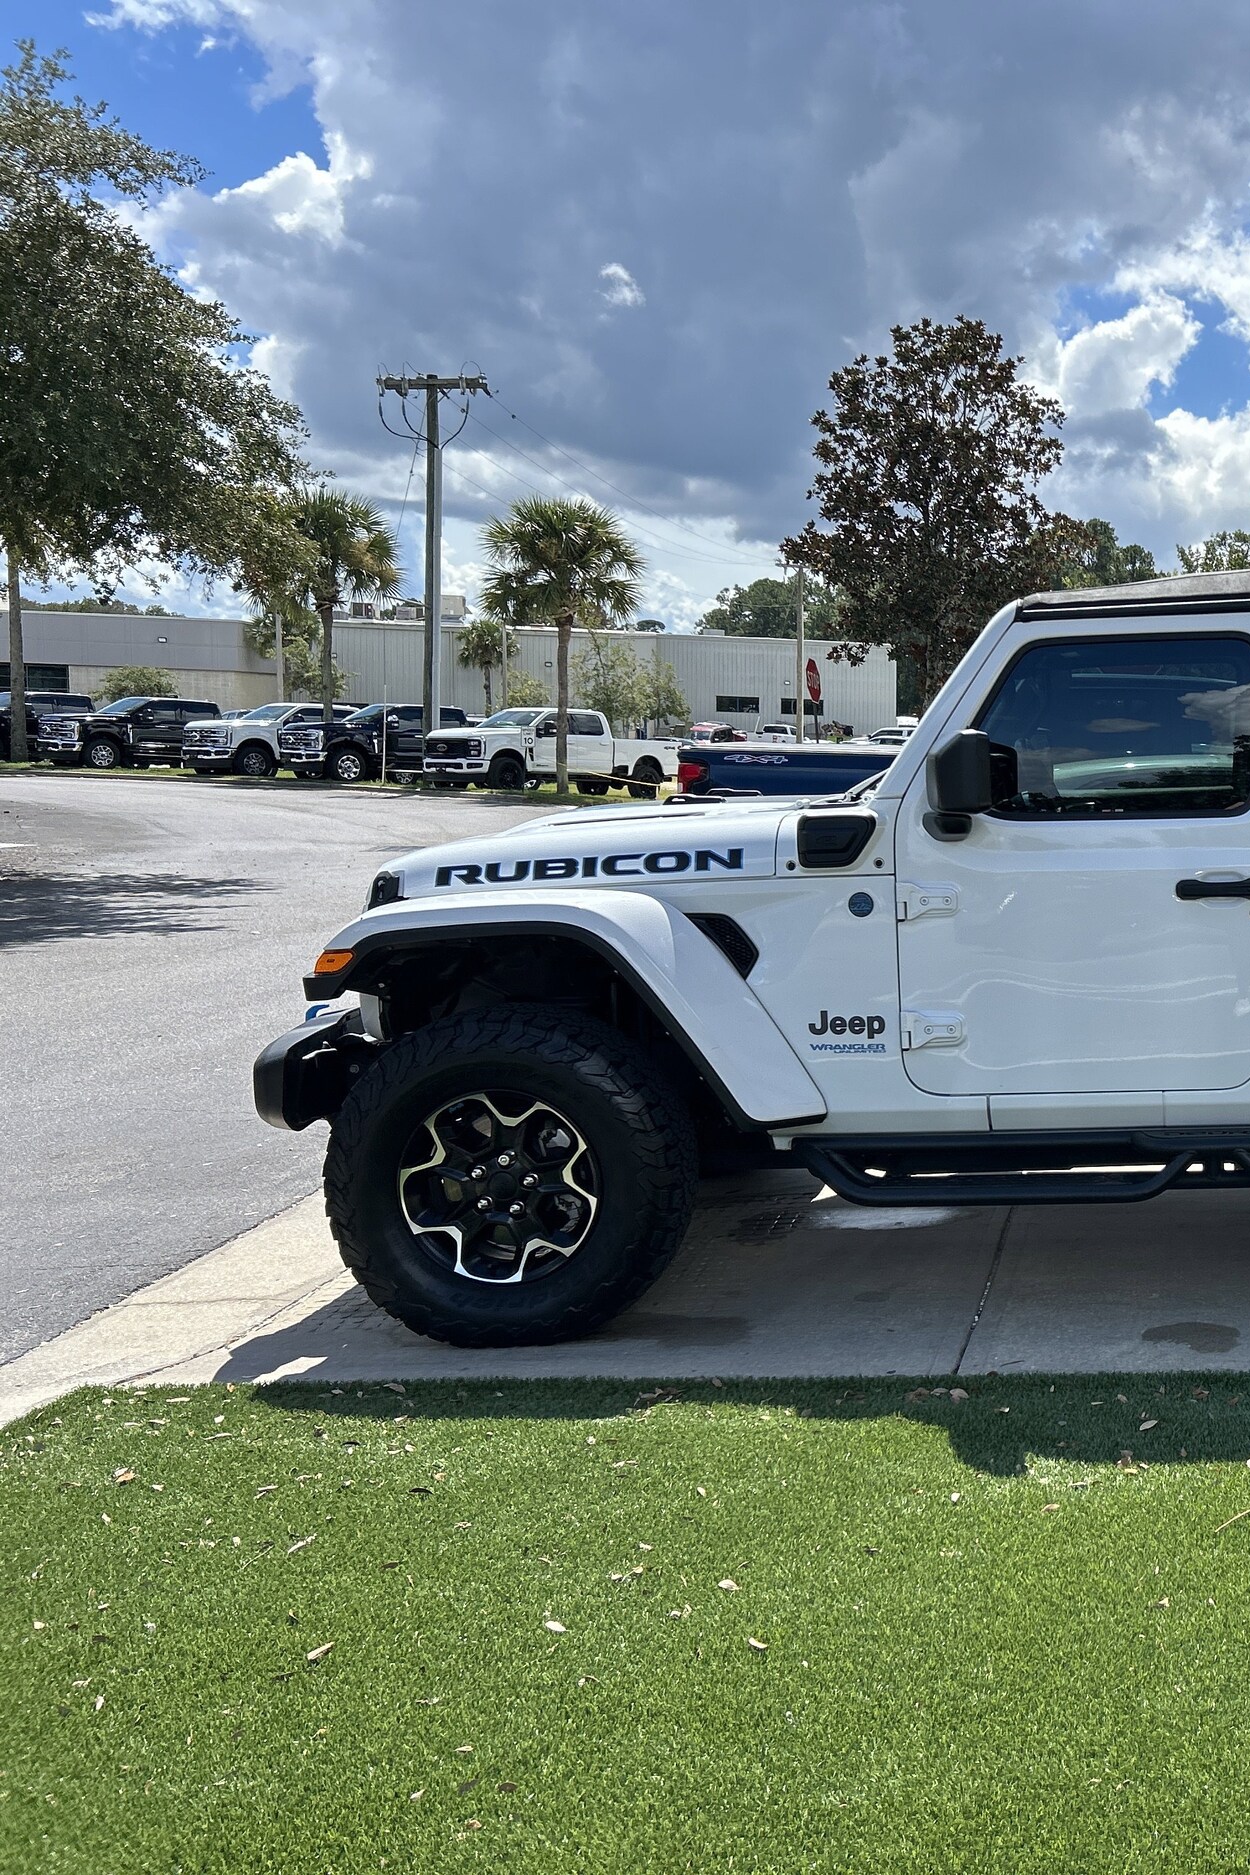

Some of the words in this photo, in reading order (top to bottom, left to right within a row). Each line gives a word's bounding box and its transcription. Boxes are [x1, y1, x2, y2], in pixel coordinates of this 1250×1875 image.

[523, 737, 534, 745] 10
[434, 848, 745, 888] RUBICON
[808, 1010, 886, 1039] Jeep
